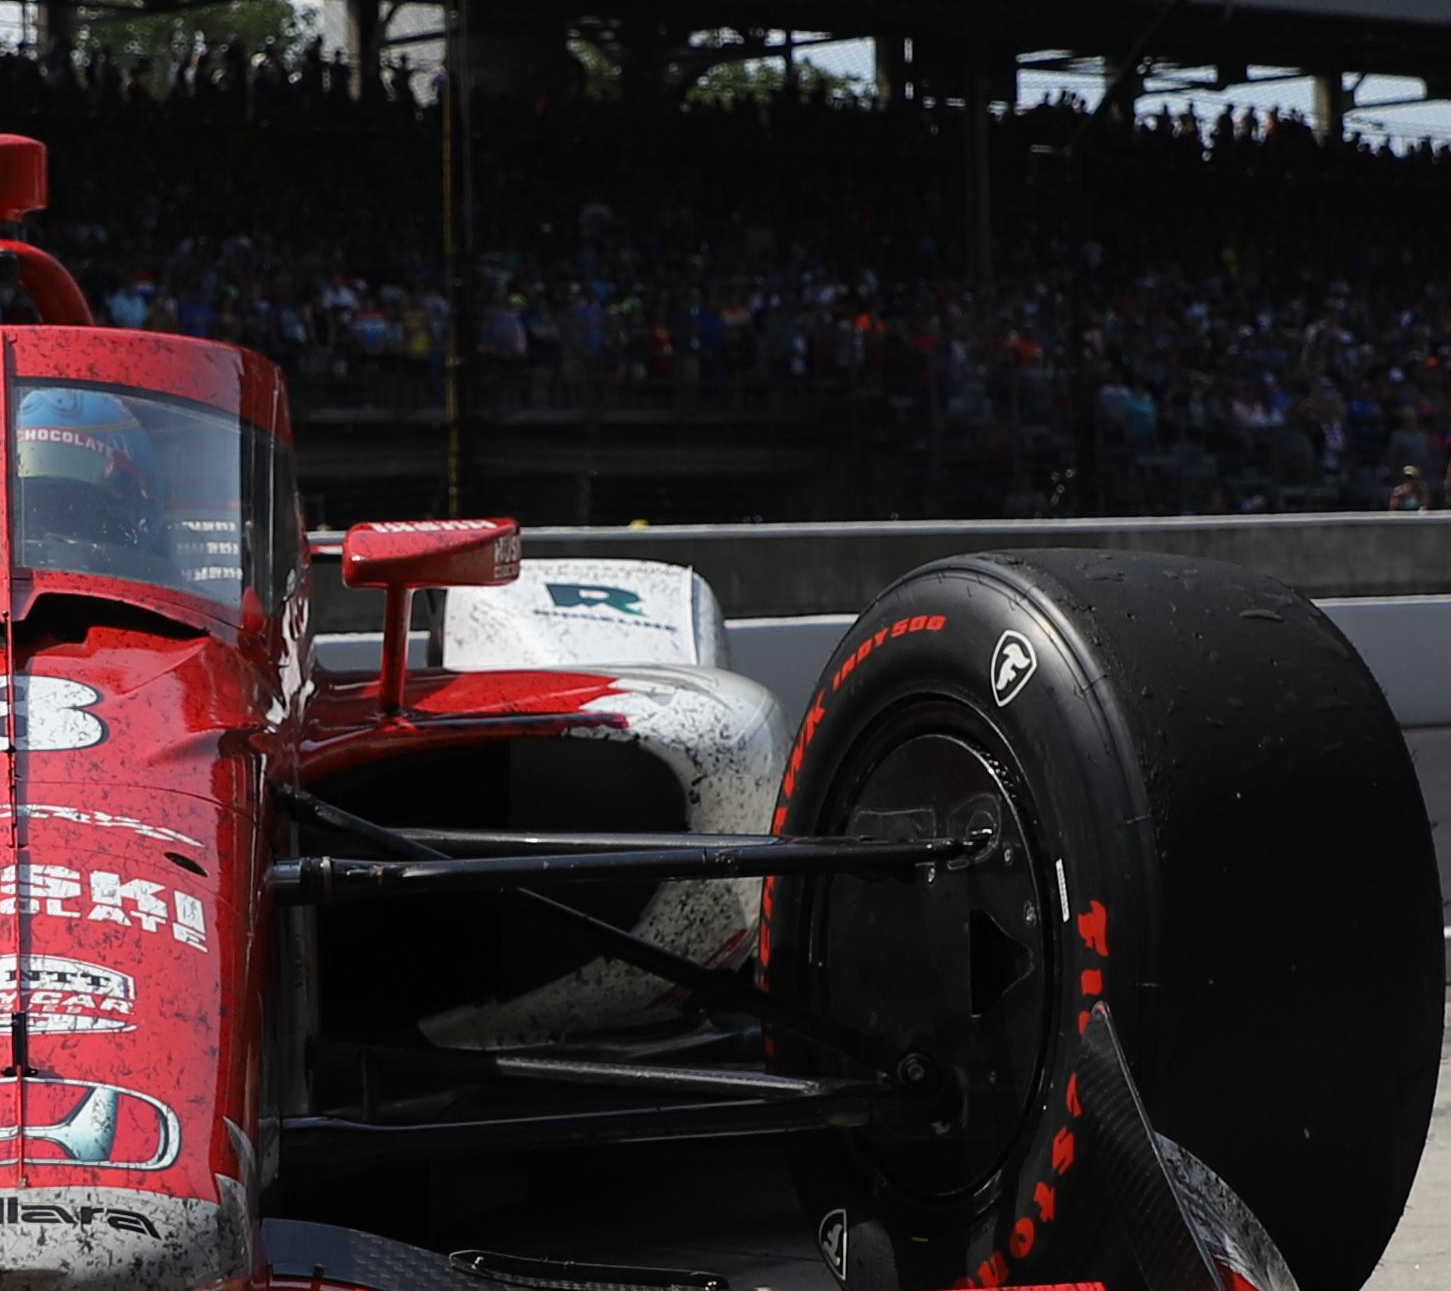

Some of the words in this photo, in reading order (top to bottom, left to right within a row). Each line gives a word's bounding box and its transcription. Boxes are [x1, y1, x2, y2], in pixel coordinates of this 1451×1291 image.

[17, 427, 116, 461] CHOCOLATE
[832, 627, 889, 692] INDY
[891, 615, 947, 639] 500
[5, 969, 110, 987] NTT
